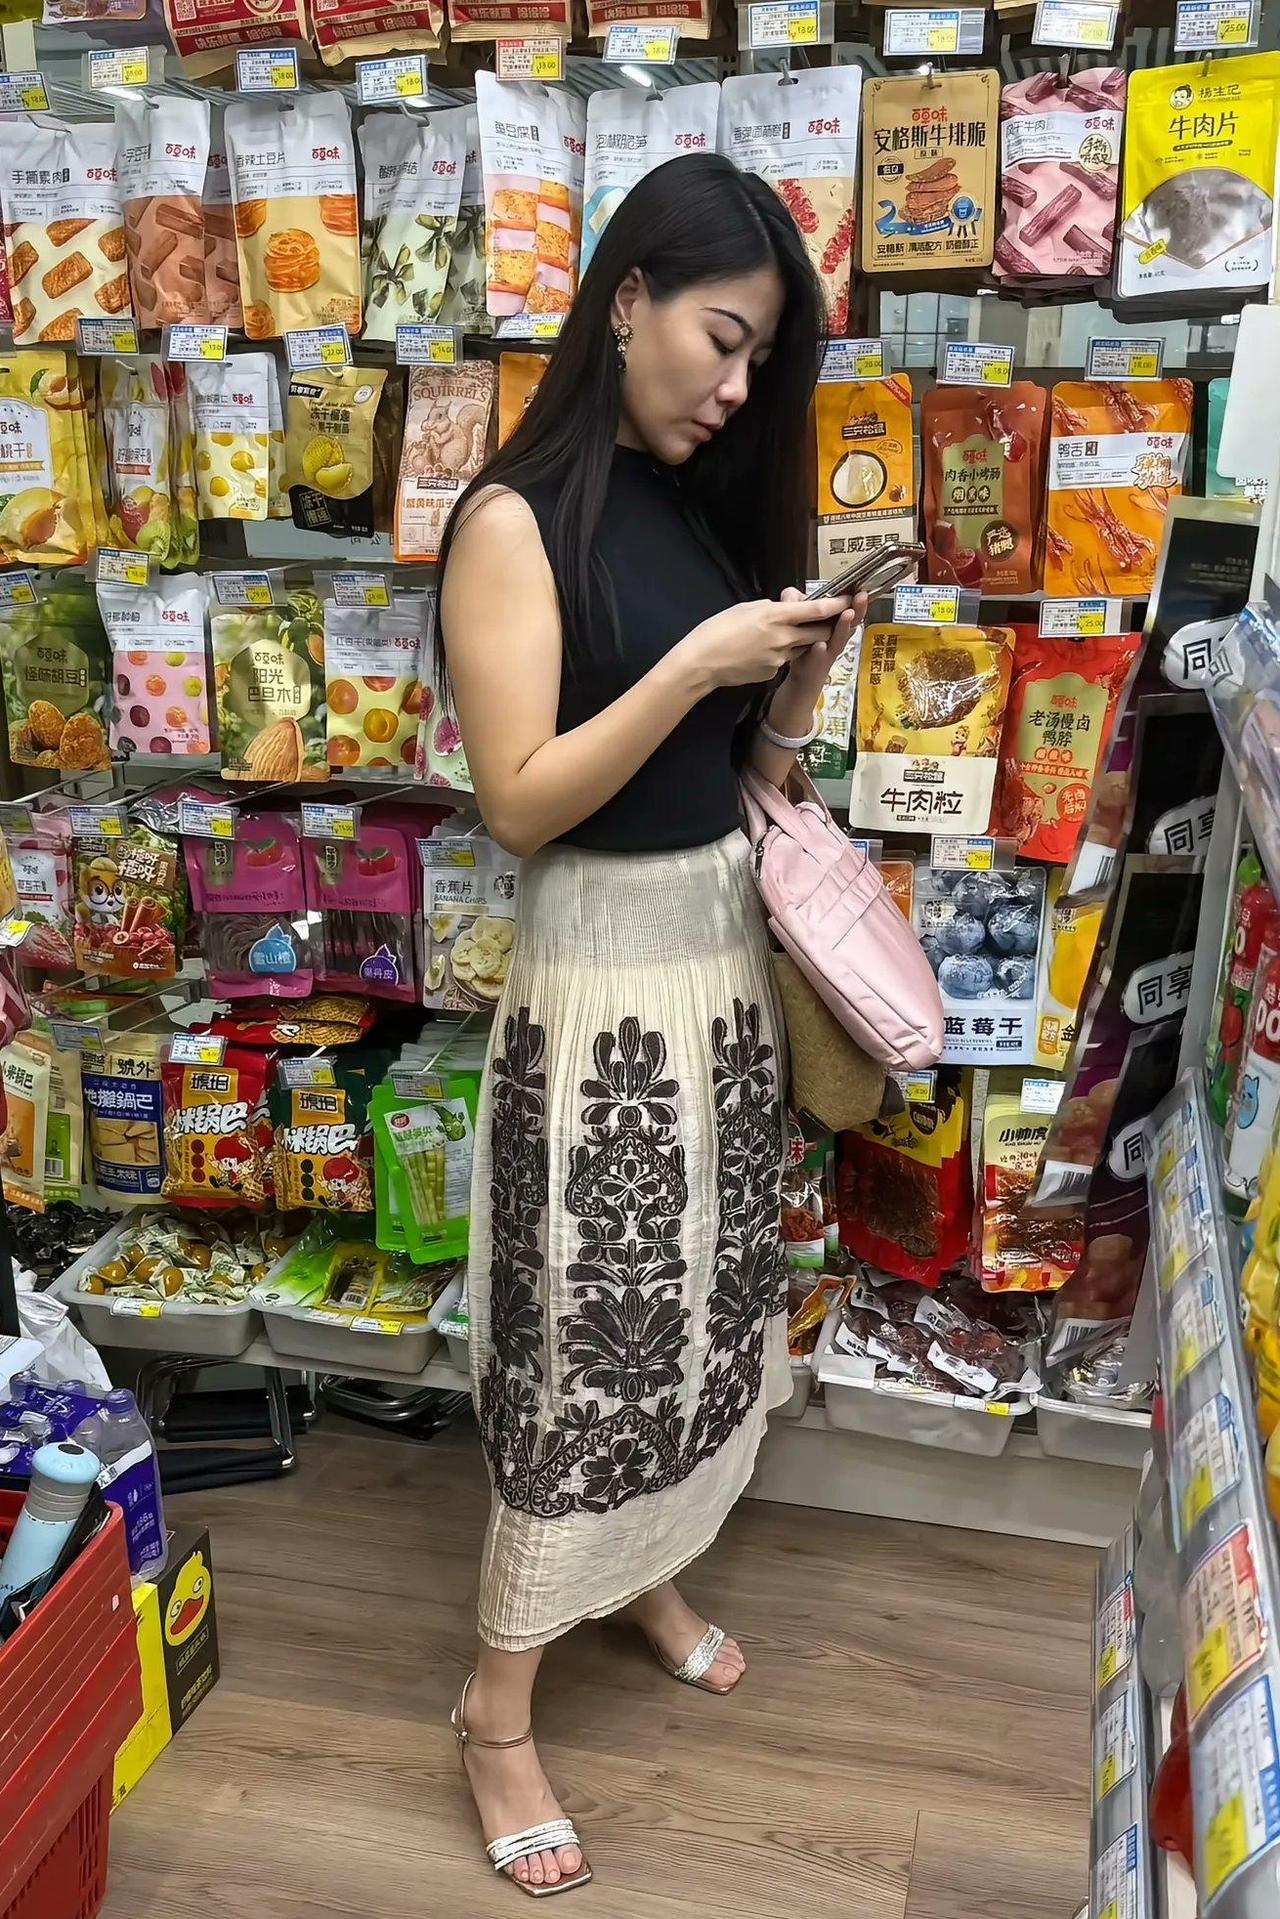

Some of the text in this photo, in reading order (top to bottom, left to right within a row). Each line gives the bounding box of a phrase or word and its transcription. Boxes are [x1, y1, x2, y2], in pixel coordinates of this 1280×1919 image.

[1199, 84, 1241, 98] 杨生记
[911, 106, 948, 123] 百草味
[807, 117, 841, 135] 百草味
[1084, 116, 1115, 131] 百草味
[1168, 111, 1240, 140] 牛肉片
[675, 132, 706, 148] 百草味
[874, 121, 986, 155] 安格斯牛排脆
[165, 143, 196, 159] 百草味
[312, 146, 340, 160] 百草味
[412, 385, 488, 402] SQUIRRELS
[1146, 436, 1173, 449] 百草味
[943, 468, 1001, 483] 肉香小烤肠
[161, 610, 190, 622] 百草味
[254, 652, 284, 665] 百草味
[253, 668, 284, 685] 阳光
[248, 687, 291, 703] 巴旦木
[880, 787, 964, 815] 牛肉粒
[434, 880, 473, 895] 香蕉片
[1138, 966, 1193, 1015] 同享
[944, 1016, 1022, 1036] 蓝莓干
[117, 1058, 155, 1078] 號外
[191, 1072, 230, 1092] 琥珀
[300, 1092, 338, 1111] 琥珀
[999, 1126, 1048, 1143] 小帅虎
